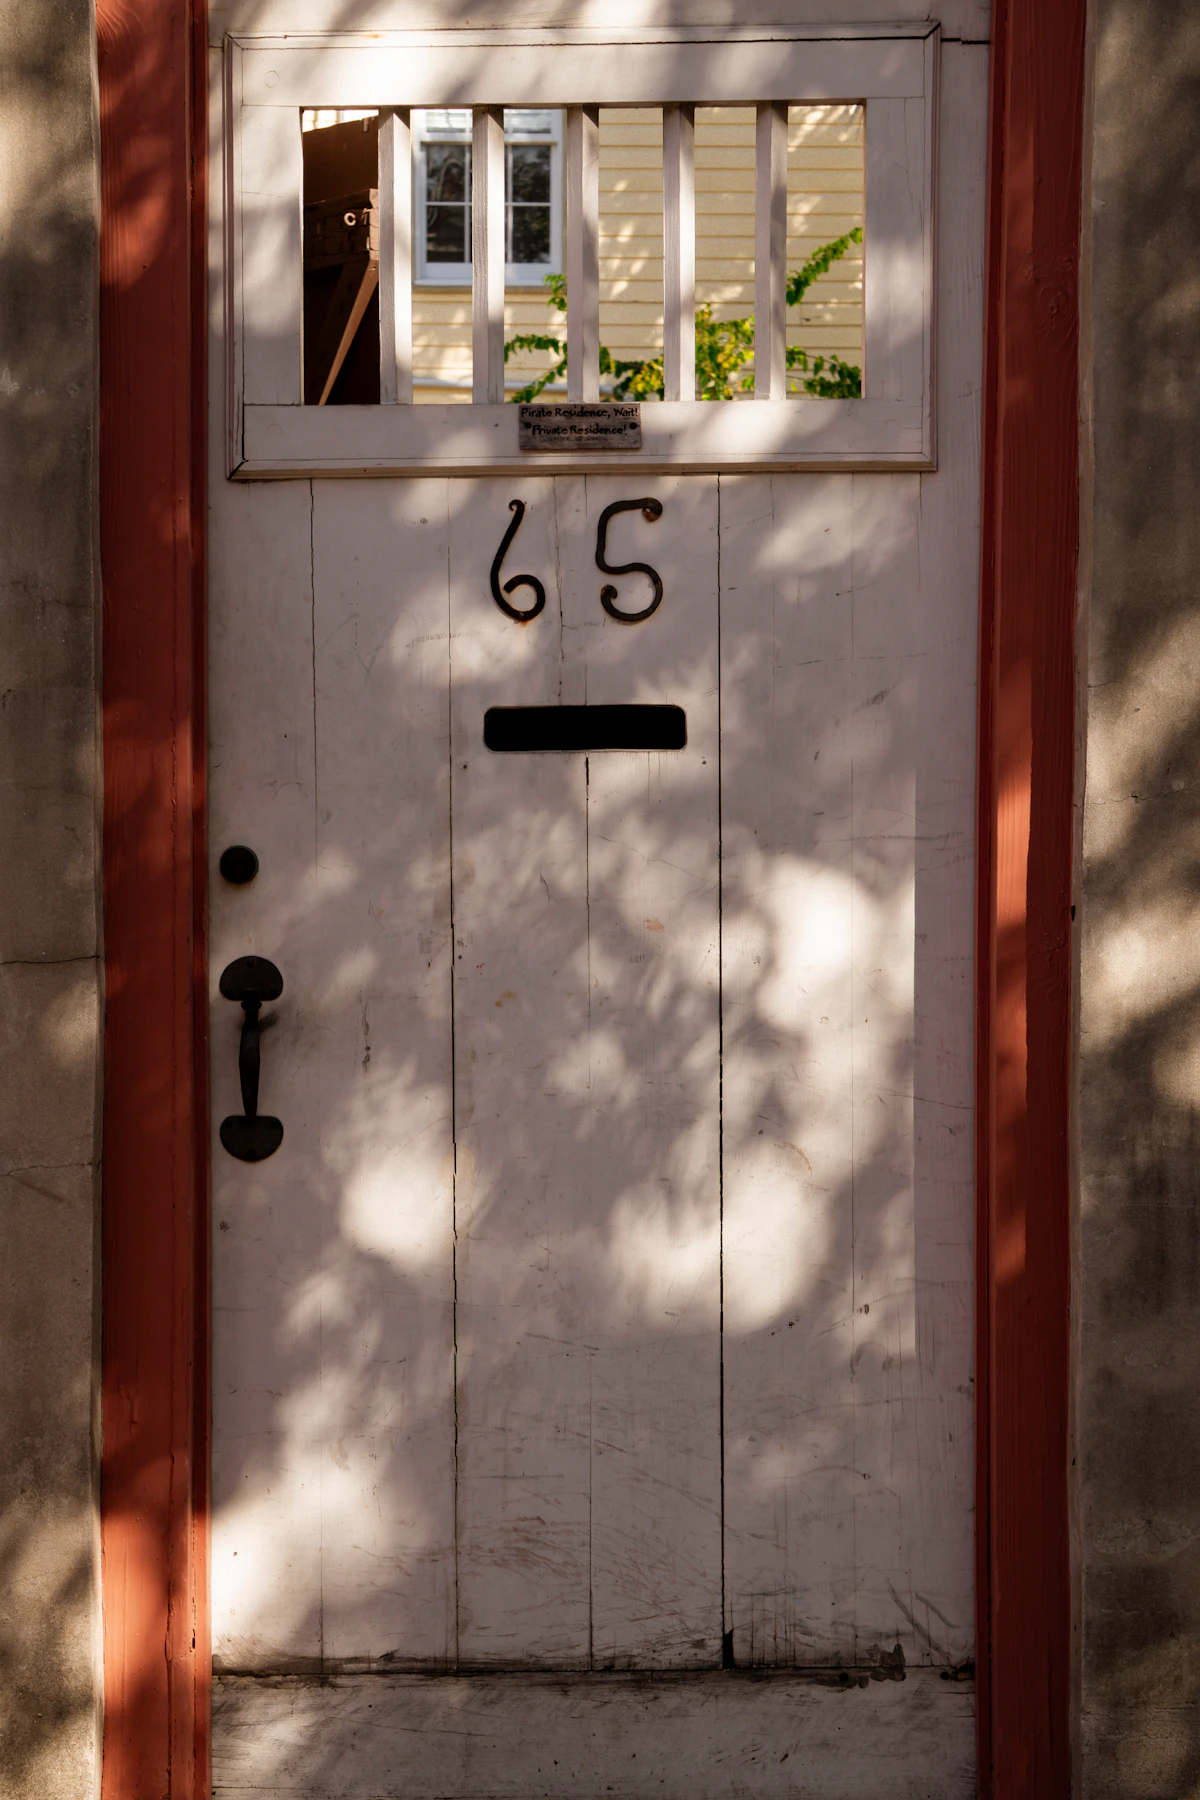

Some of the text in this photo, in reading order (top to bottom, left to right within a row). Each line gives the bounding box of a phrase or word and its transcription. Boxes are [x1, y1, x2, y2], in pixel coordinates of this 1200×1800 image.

[521, 406, 638, 419] Pirate Residence, Wait!
[532, 424, 627, 436] Private Residence!
[490, 497, 663, 622] 65
